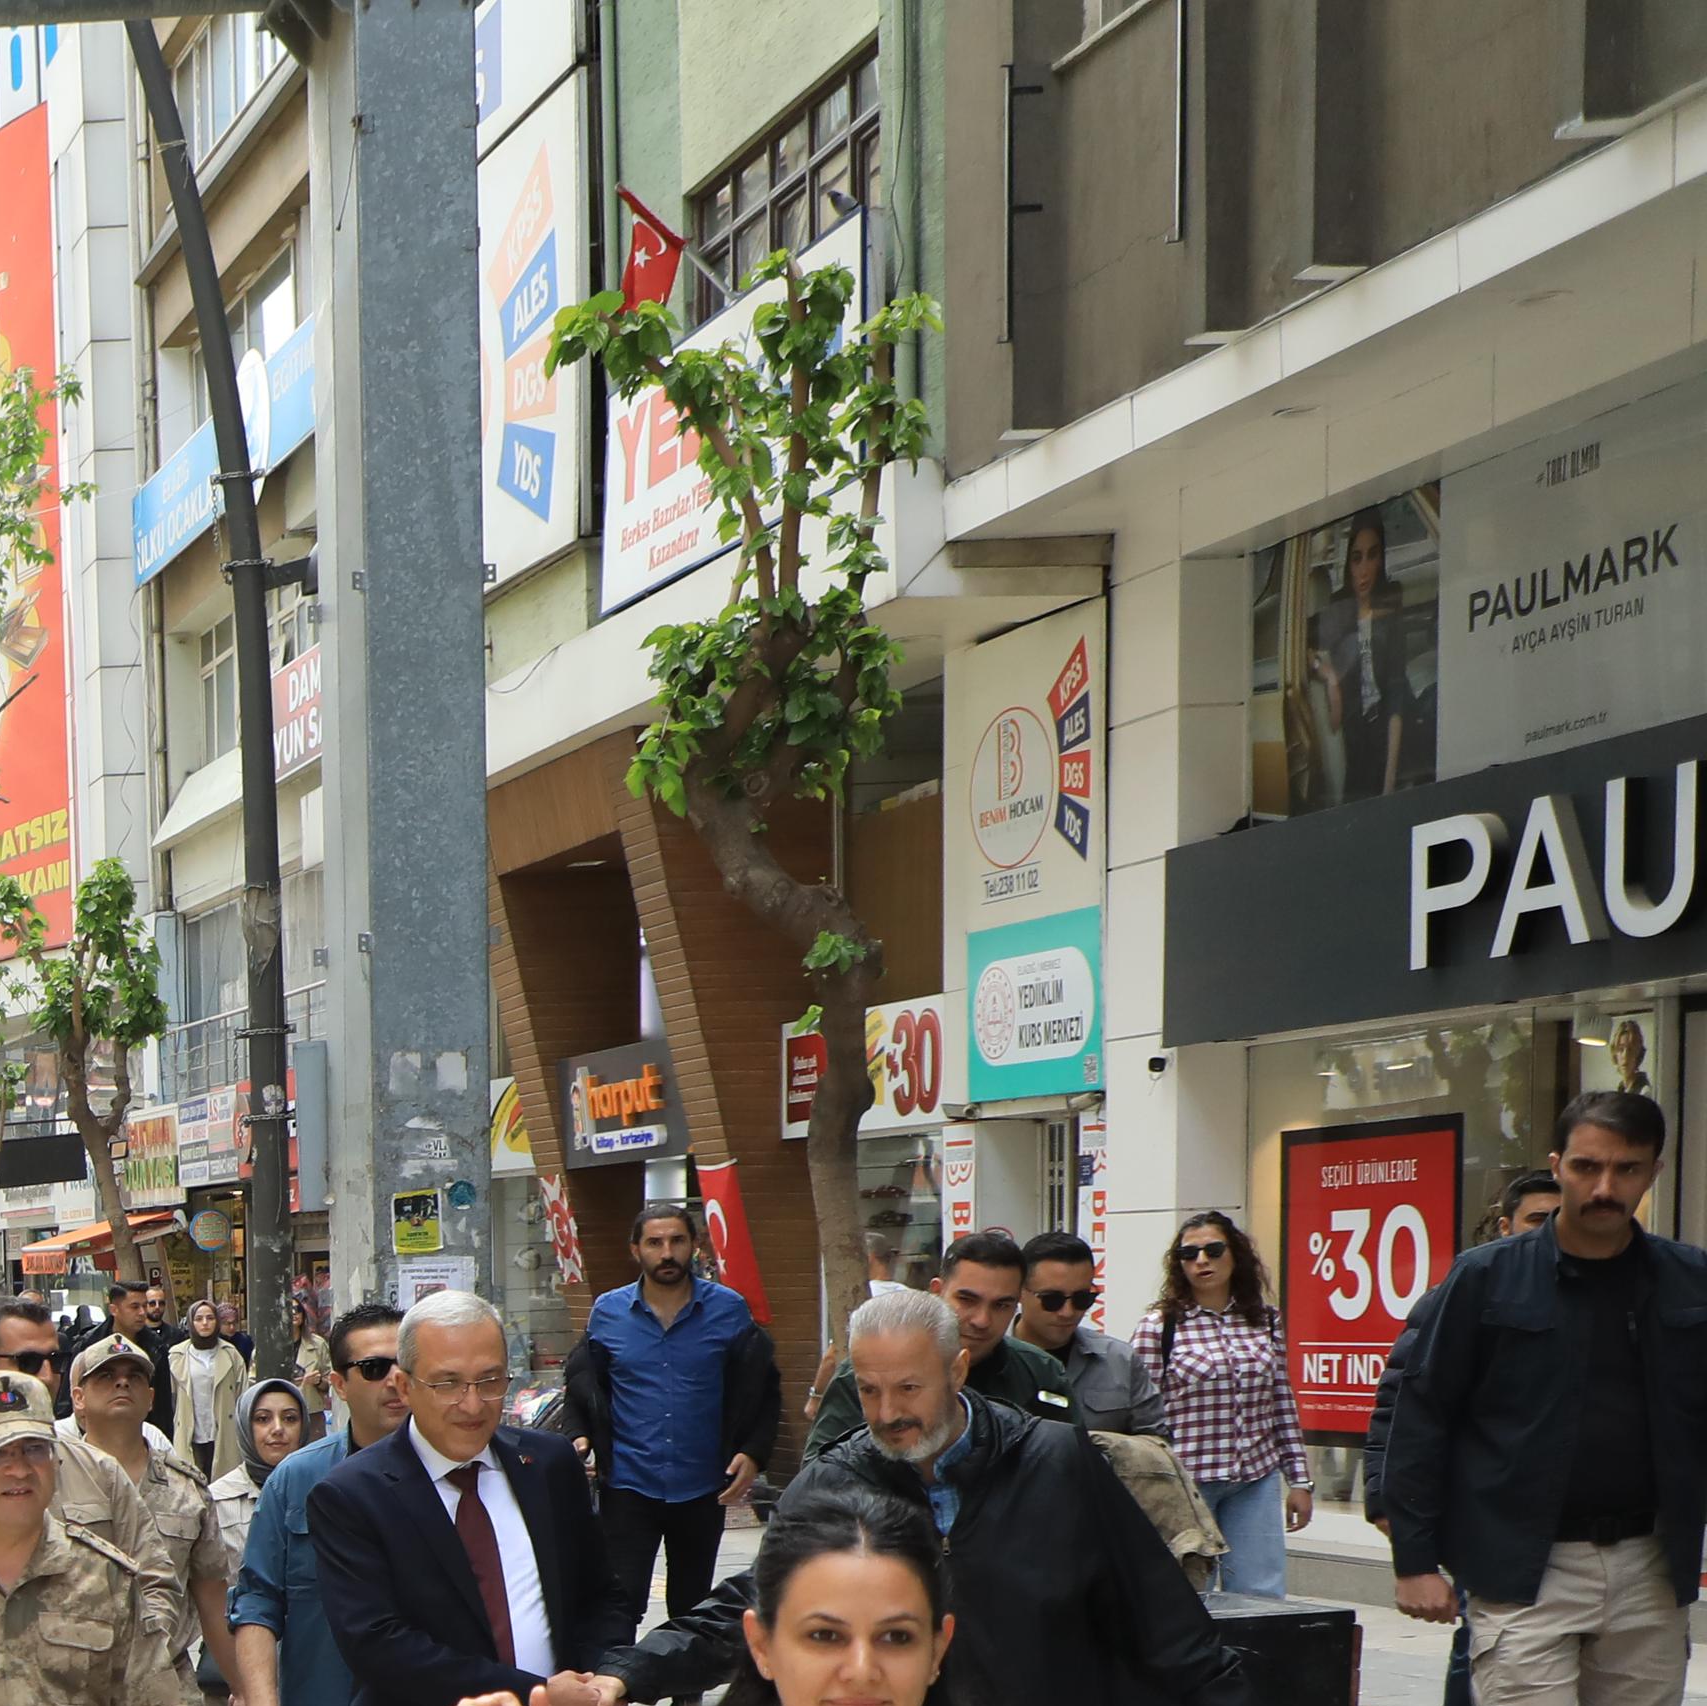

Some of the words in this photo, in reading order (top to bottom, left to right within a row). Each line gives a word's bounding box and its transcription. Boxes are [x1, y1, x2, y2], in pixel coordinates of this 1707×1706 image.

[504, 177, 545, 279] KPSS
[512, 274, 551, 336] ALES
[513, 357, 547, 407] DGS
[513, 440, 542, 500] YDS
[136, 522, 167, 575] ÜLKÜ
[621, 520, 650, 552] Herkes
[1468, 523, 1680, 634] PAULMARK
[1512, 627, 1547, 655] AYÇA
[1550, 611, 1591, 643] AYŞİN
[1593, 596, 1646, 630] TURAN
[1058, 654, 1083, 706] KPSS
[273, 721, 306, 772] YUN
[1064, 708, 1086, 747] ALES
[1524, 711, 1609, 746] paulmark.com.tr
[1064, 760, 1085, 791] DGS
[979, 804, 1008, 830] BENİM
[1008, 794, 1044, 820] HOCAM
[1064, 806, 1083, 846] YDS
[1018, 1022, 1043, 1052] KURS
[1043, 1009, 1084, 1048] MERKEZİ
[587, 1064, 666, 1127] harput
[1320, 1162, 1354, 1190] SEÇİLİ
[1356, 1157, 1418, 1185] ÜRÜNLERDE
[1309, 1203, 1431, 1322] %30
[1302, 1352, 1340, 1386] NET
[1345, 1351, 1389, 1386] İND
